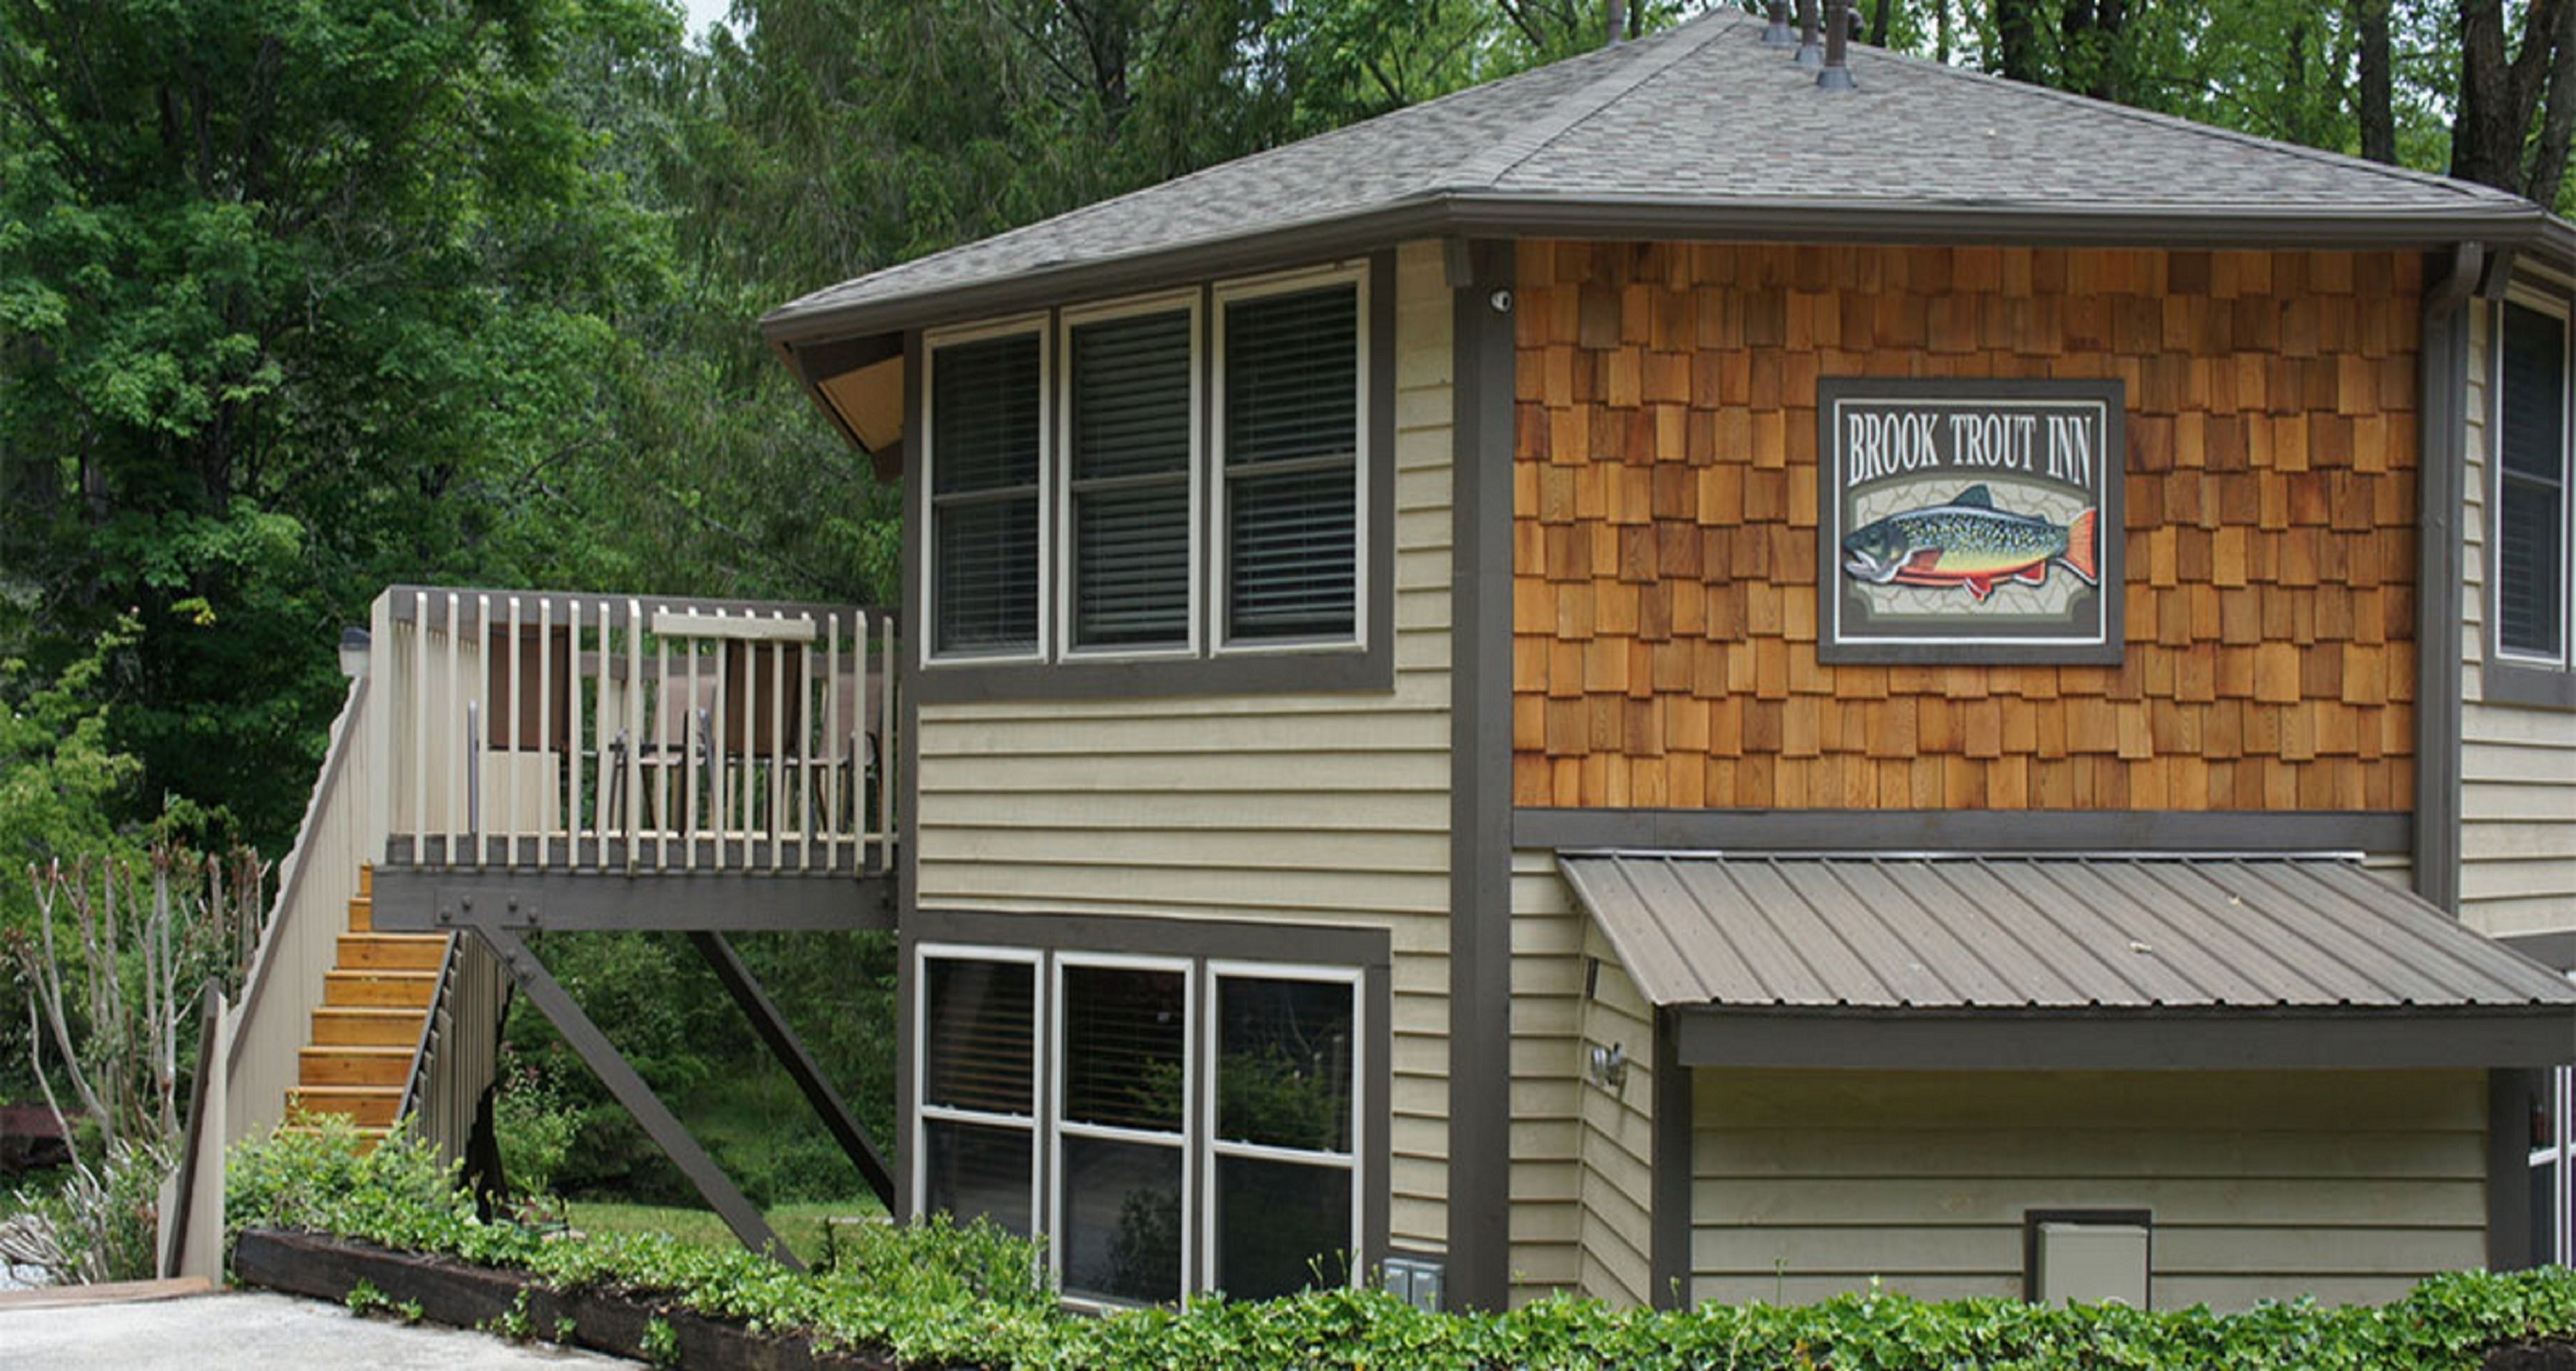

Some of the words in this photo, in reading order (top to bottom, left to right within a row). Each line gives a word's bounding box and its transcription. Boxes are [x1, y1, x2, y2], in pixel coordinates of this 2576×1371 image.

[1847, 412, 1940, 487] BROOK
[1949, 413, 2036, 471] TROUT
[2046, 415, 2092, 490] INN
